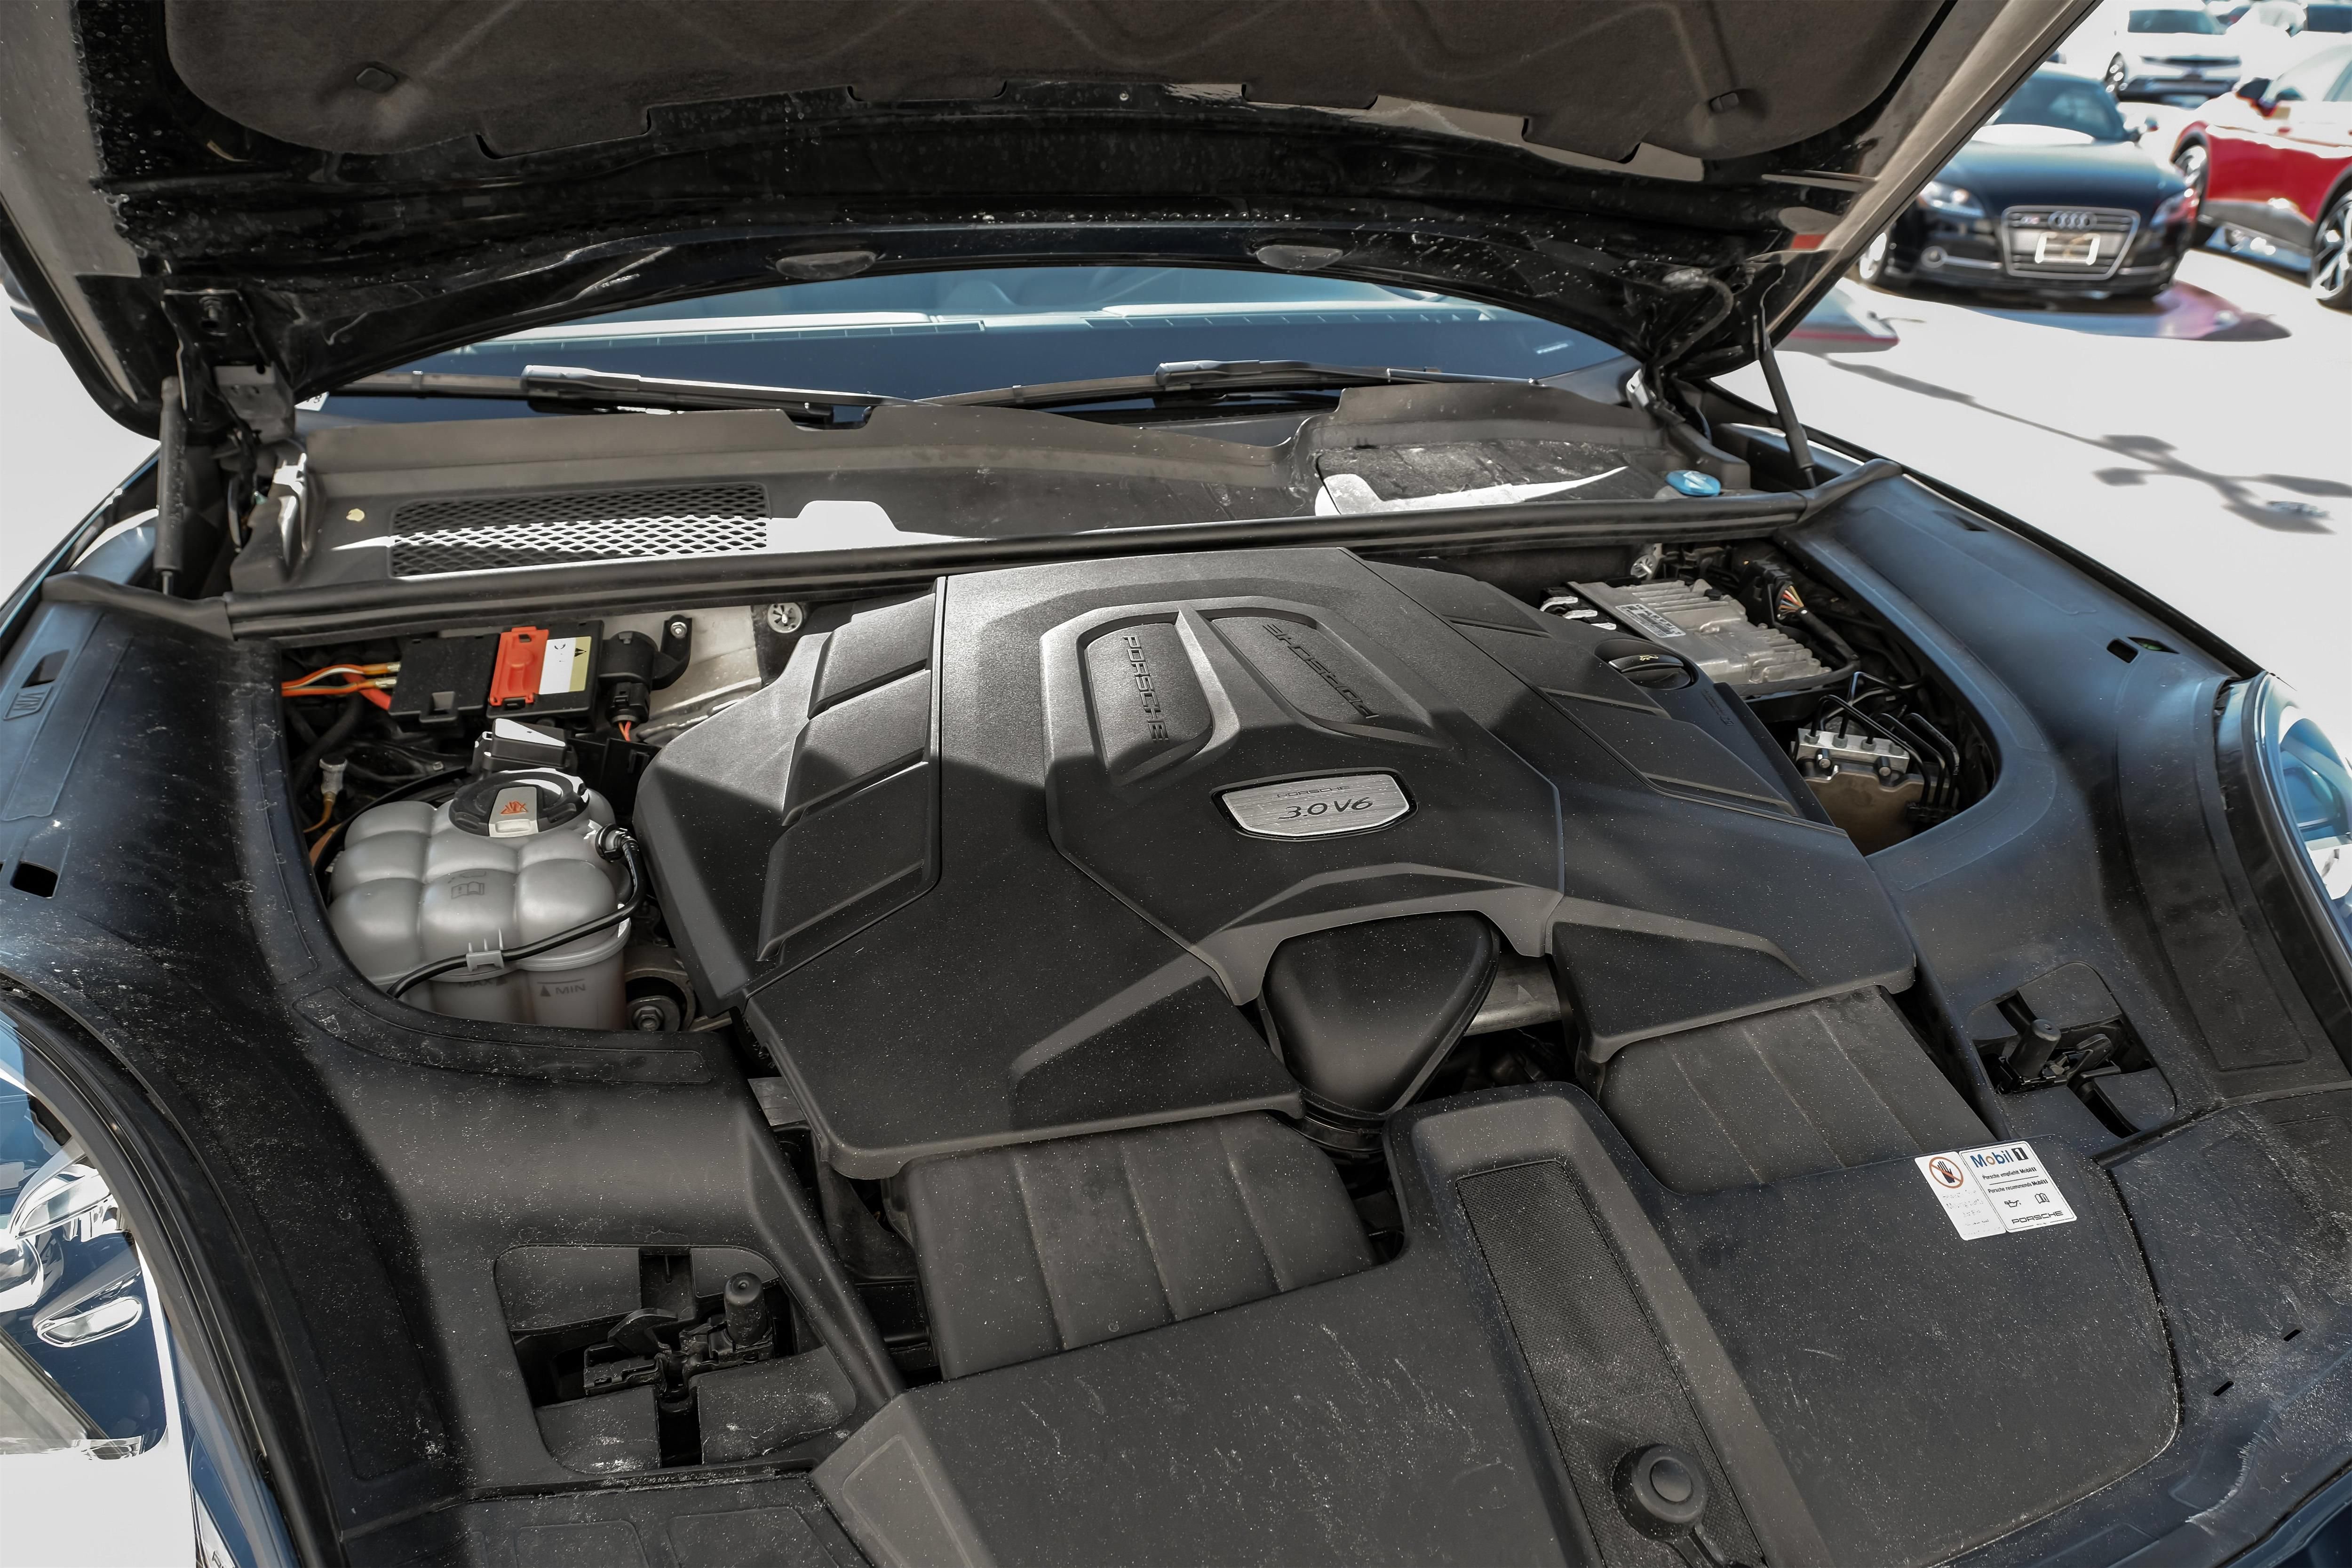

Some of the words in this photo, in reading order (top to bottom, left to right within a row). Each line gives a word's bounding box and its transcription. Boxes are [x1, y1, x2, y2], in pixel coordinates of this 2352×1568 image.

[1263, 624, 1379, 719] PORSCHE
[1122, 636, 1169, 740] PORSCHE
[12, 692, 45, 710] VIN
[1277, 786, 1351, 798] PORSCHE
[1278, 803, 1328, 820] 3.0
[1334, 796, 1373, 812] V6
[555, 984, 586, 995] MIN
[1970, 1150, 2014, 1168] Mobil
[2011, 1210, 2064, 1224] PORSCHE
